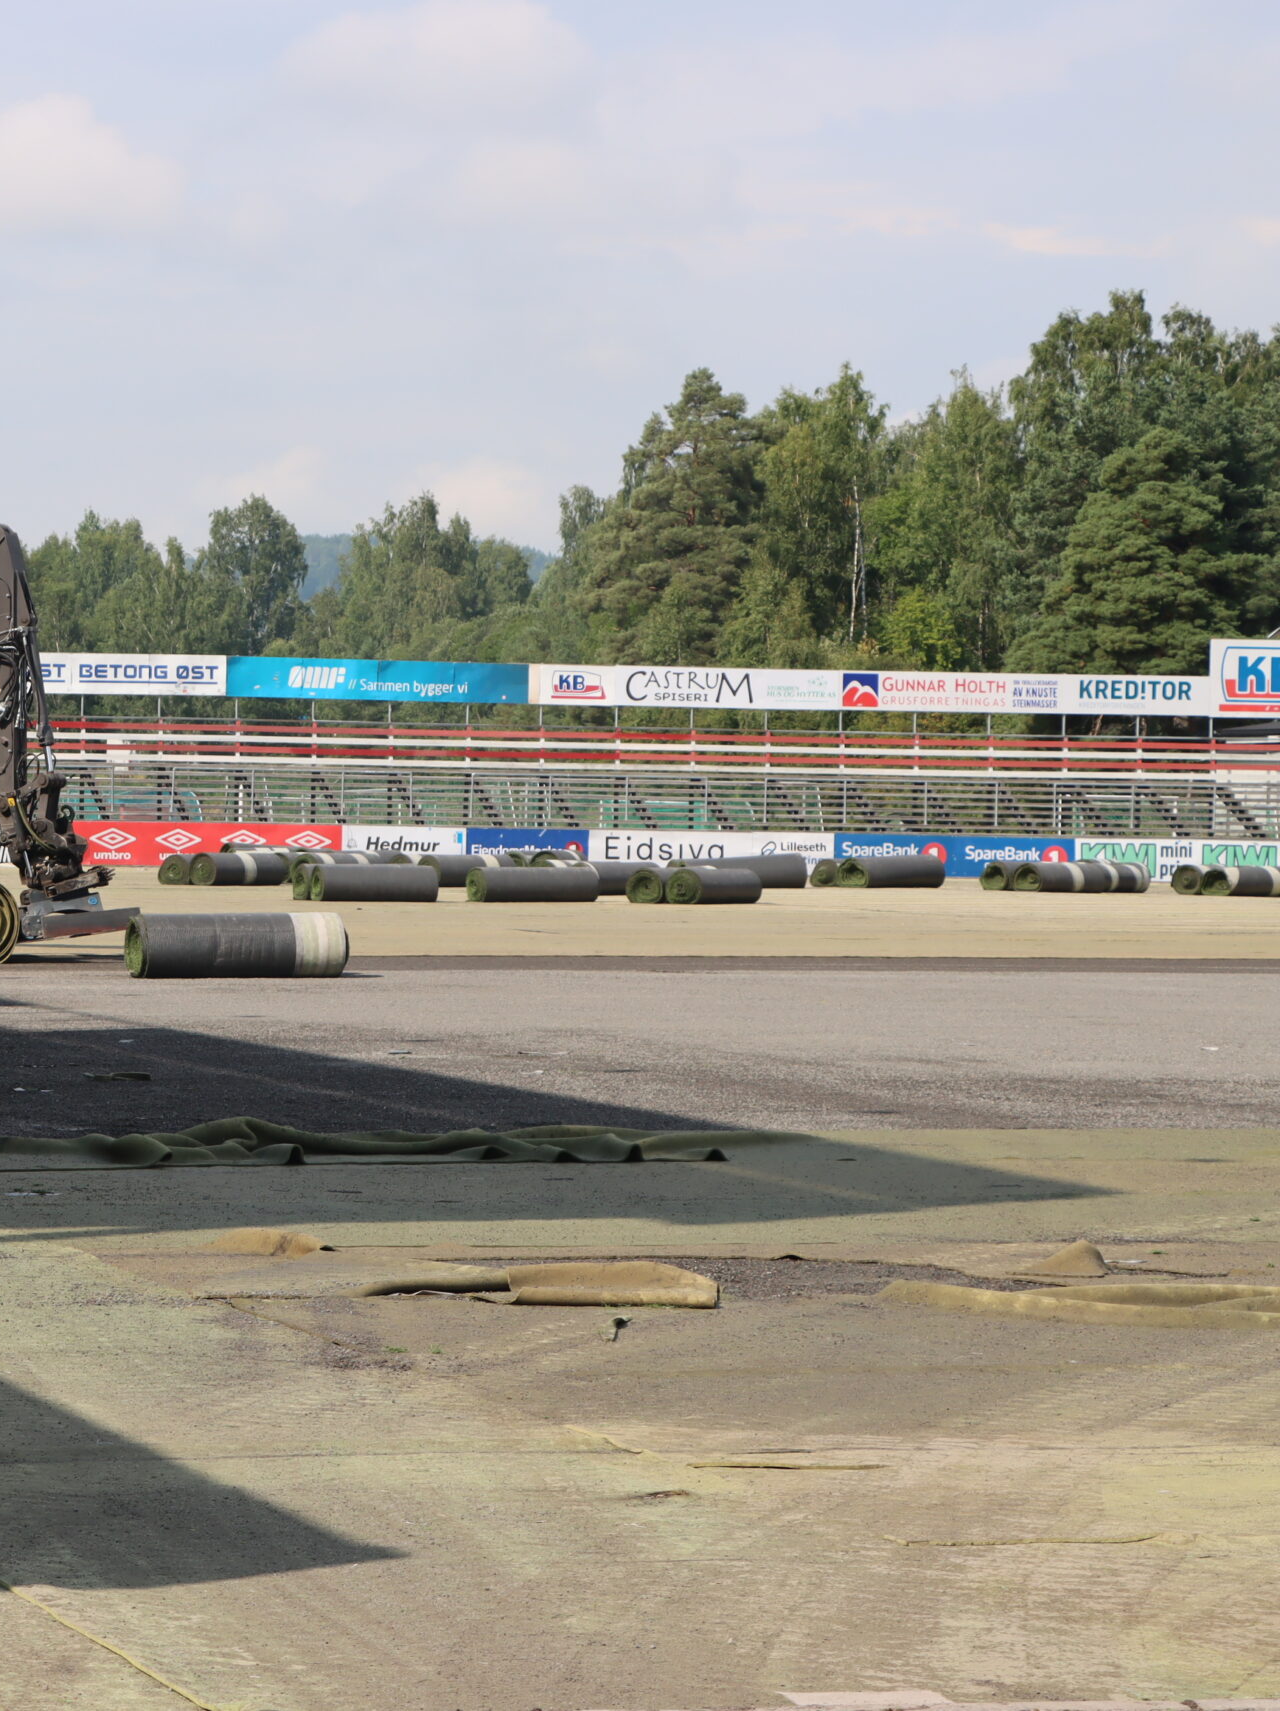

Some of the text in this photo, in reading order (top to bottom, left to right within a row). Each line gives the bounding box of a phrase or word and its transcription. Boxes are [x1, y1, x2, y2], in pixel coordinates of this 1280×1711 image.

[42, 663, 66, 678] ST
[176, 665, 219, 680] ØST
[360, 678, 410, 692] Sammen
[413, 680, 454, 697] bygger
[457, 682, 468, 693] vi
[558, 674, 585, 691] KB
[882, 677, 1007, 694] GUNNAR HOLTH
[654, 692, 708, 702] SPISERI
[1026, 687, 1058, 698] KNUSTE
[366, 836, 440, 853] Hedmur
[780, 842, 827, 852] Lilleseth
[841, 842, 919, 858] SpareBank
[1160, 841, 1193, 858] mini
[94, 851, 131, 860] umbro
[965, 845, 1040, 861] SpareBank
[1080, 842, 1156, 878] KIWI
[1202, 844, 1278, 867] KIWI
